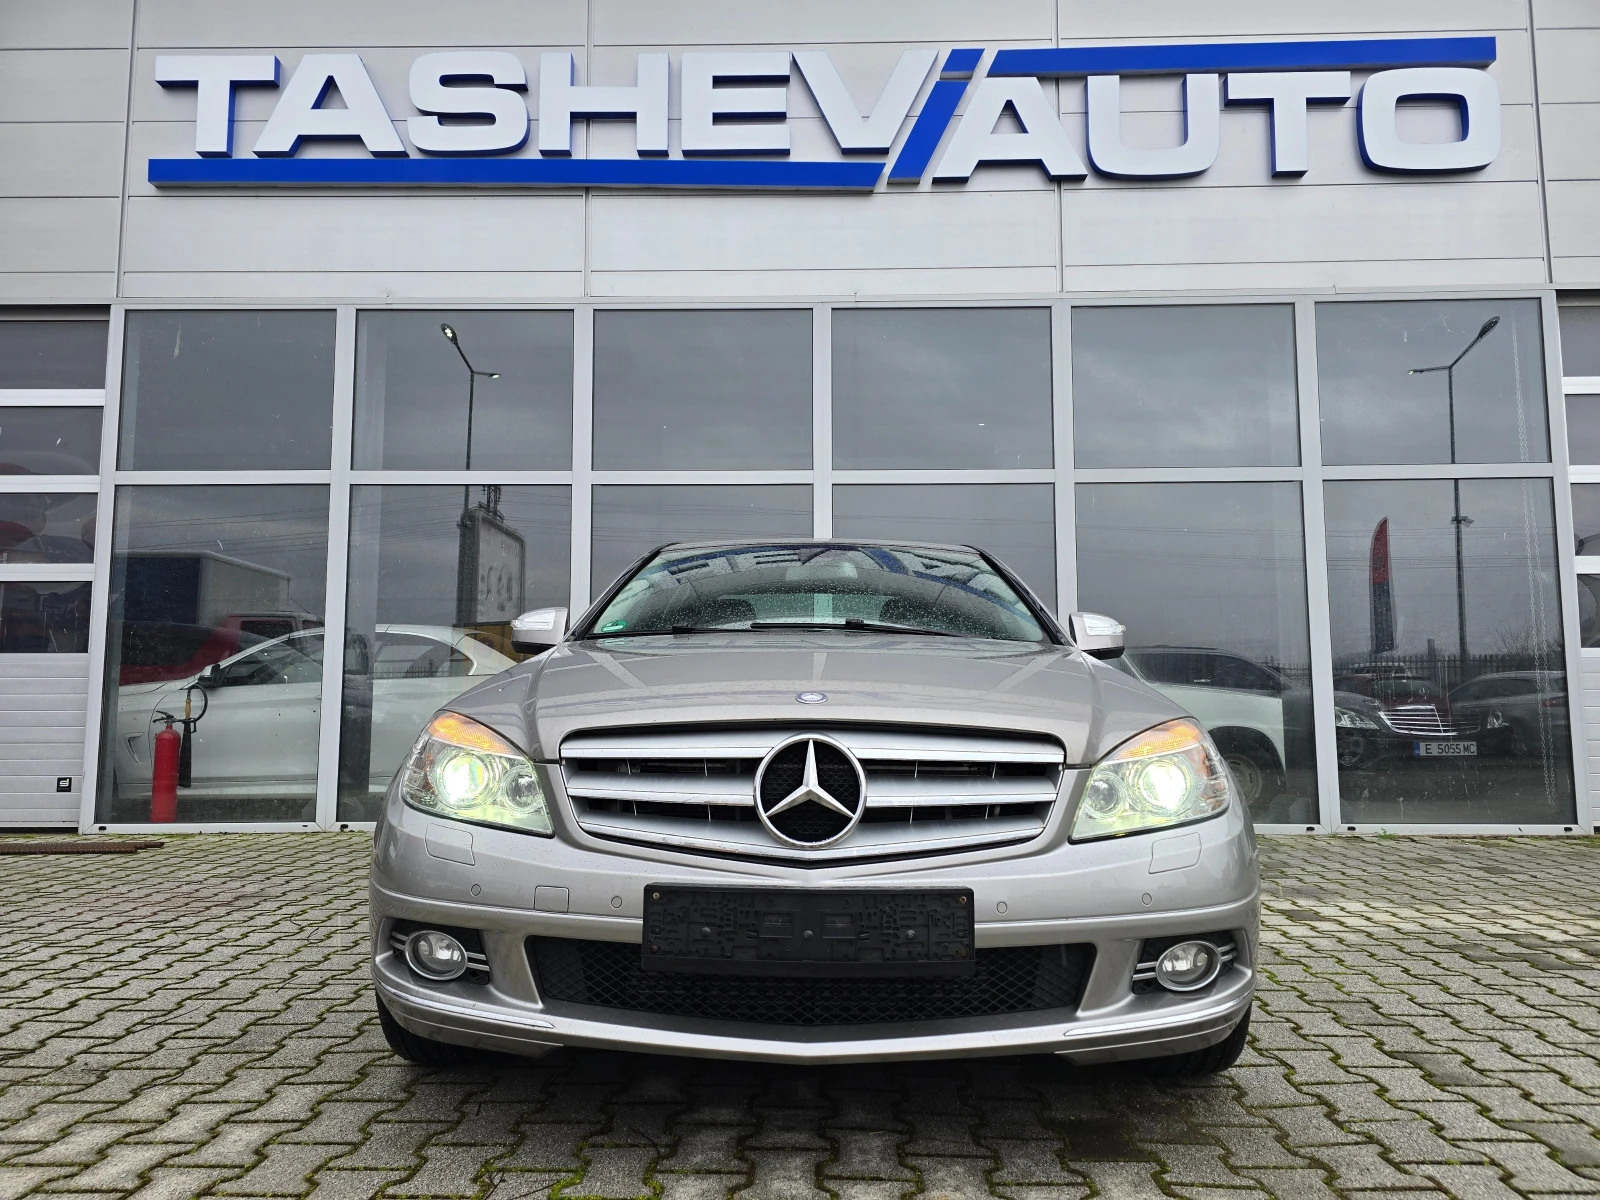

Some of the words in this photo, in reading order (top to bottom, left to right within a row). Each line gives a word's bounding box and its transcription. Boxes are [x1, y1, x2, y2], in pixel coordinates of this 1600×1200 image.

[155, 49, 940, 158] TASHEV
[931, 66, 1502, 184] AUTO
[1425, 743, 1432, 754] E
[1437, 743, 1461, 754] 5055
[1463, 743, 1475, 754] MC
